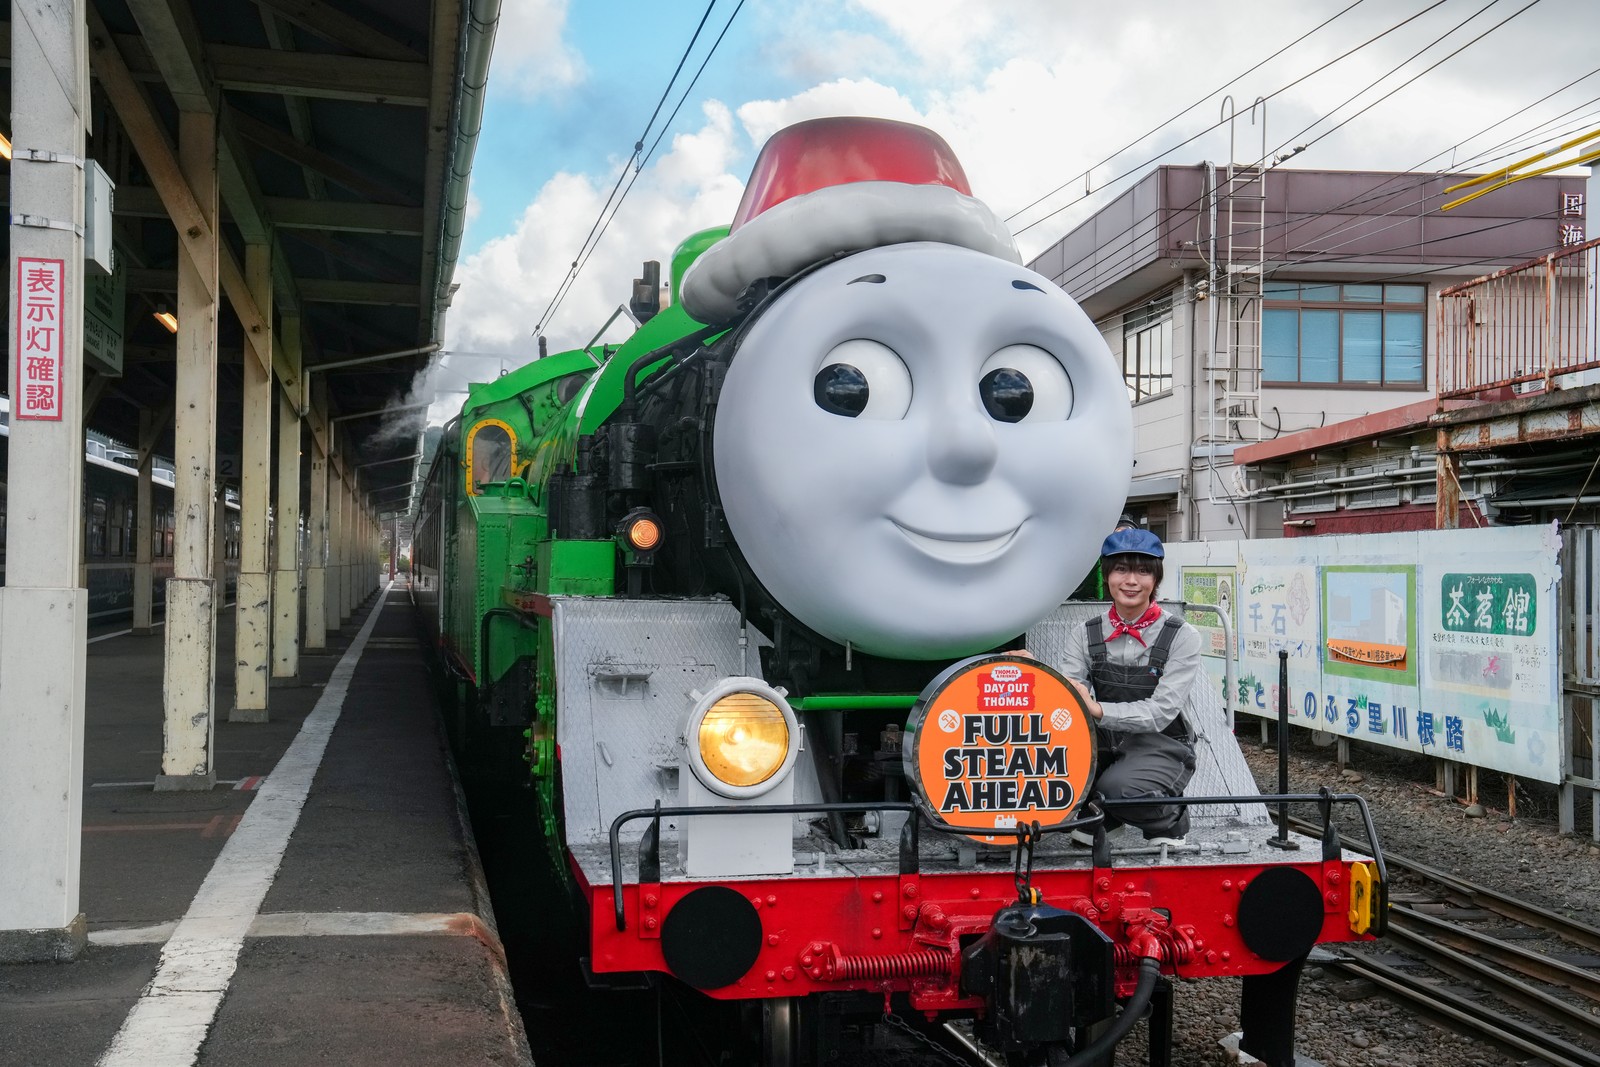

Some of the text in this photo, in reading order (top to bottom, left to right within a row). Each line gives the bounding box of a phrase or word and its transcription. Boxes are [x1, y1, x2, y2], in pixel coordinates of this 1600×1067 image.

[26, 267, 55, 411] 表示灯確認
[220, 459, 233, 475] 2
[1248, 602, 1287, 635] 千石
[983, 683, 1029, 694] DAY OUT
[983, 696, 1029, 707] THOMAS
[962, 713, 1051, 746] FULL
[943, 746, 1069, 780] STEAM
[939, 779, 1075, 813] AHEAD
